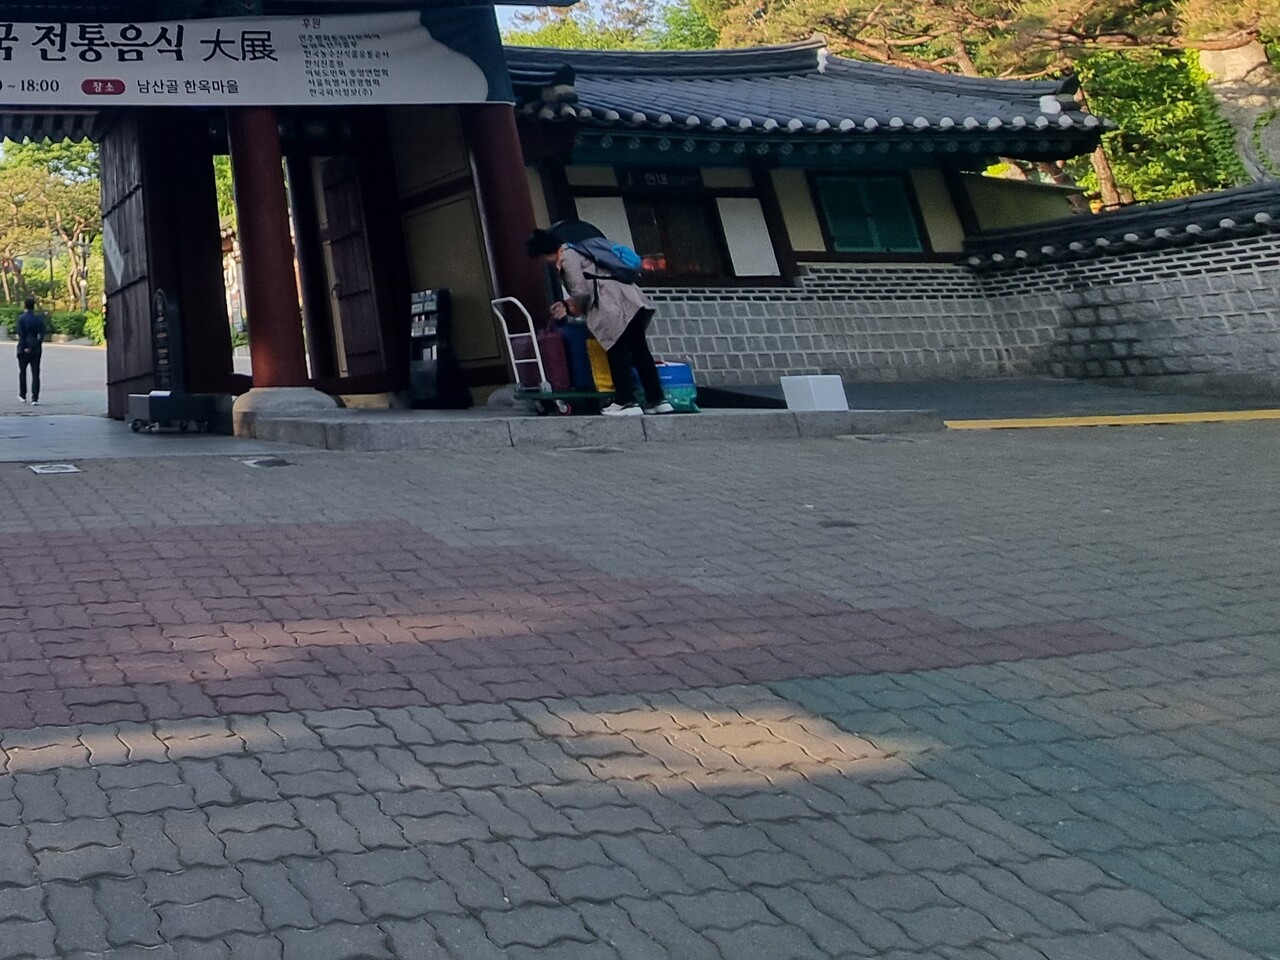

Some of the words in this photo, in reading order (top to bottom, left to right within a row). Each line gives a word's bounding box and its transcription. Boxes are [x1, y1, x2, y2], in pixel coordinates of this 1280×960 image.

[32, 22, 185, 62] 전통음식
[200, 28, 279, 62] 大展
[20, 79, 60, 92] 18:00
[137, 79, 179, 94] 남산골
[183, 79, 240, 94] 한옥마을
